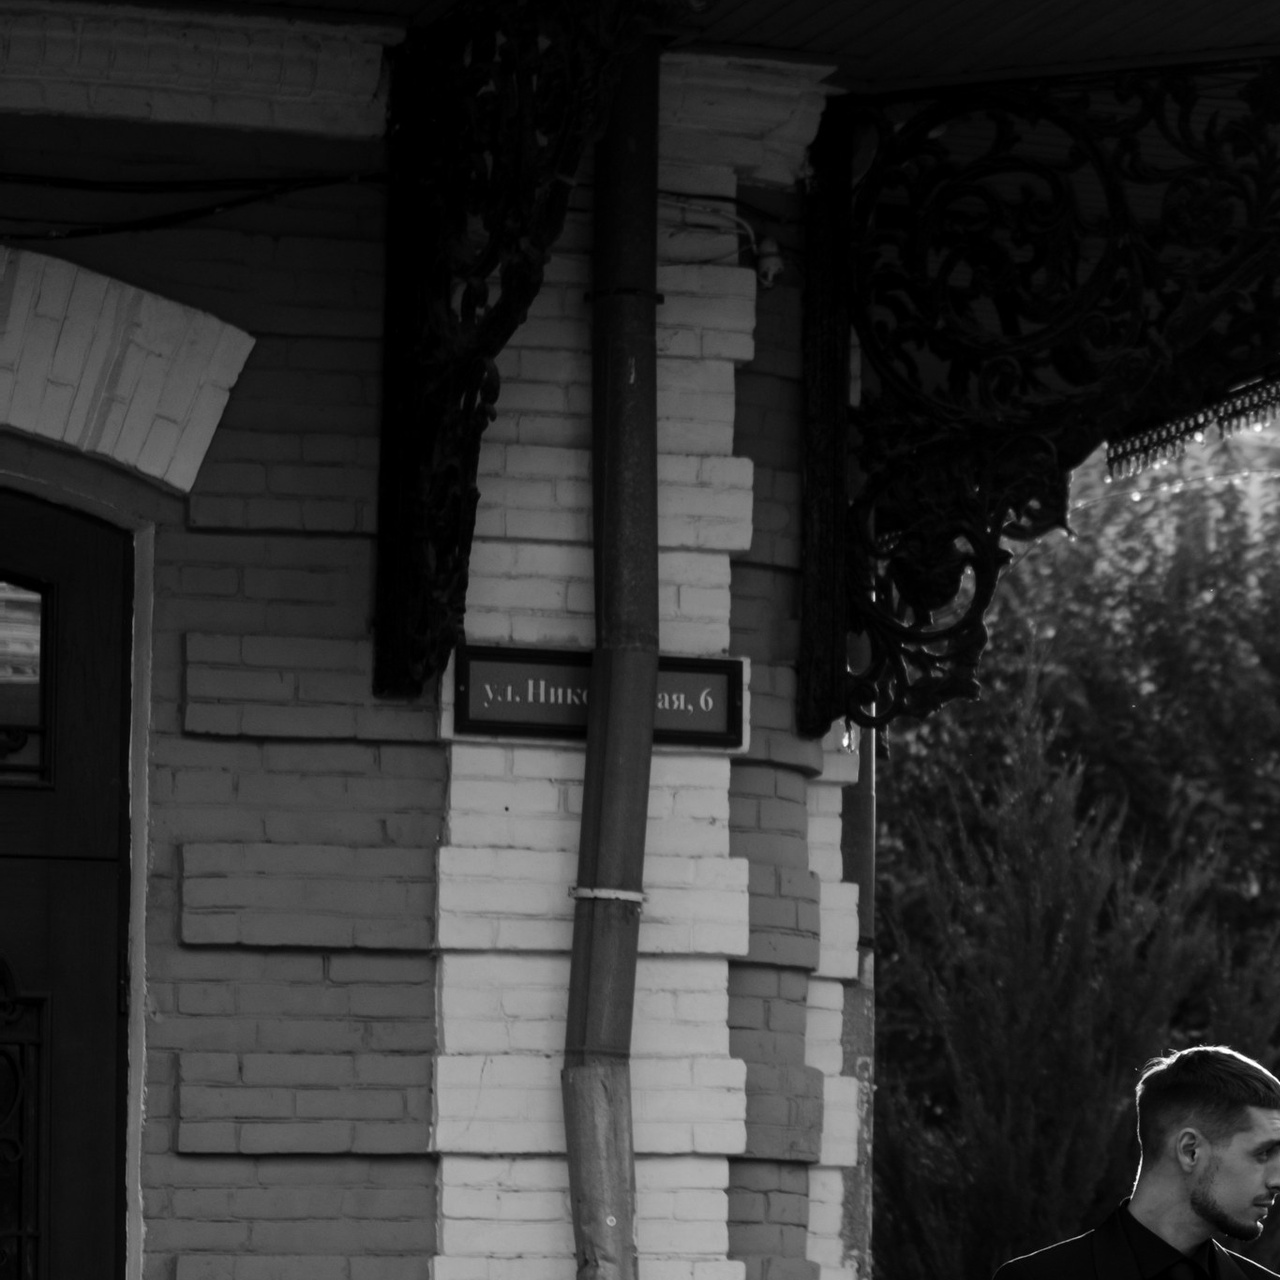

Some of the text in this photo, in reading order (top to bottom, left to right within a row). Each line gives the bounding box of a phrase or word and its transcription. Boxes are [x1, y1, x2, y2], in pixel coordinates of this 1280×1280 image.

[484, 678, 714, 716] ул. Никая, 6
